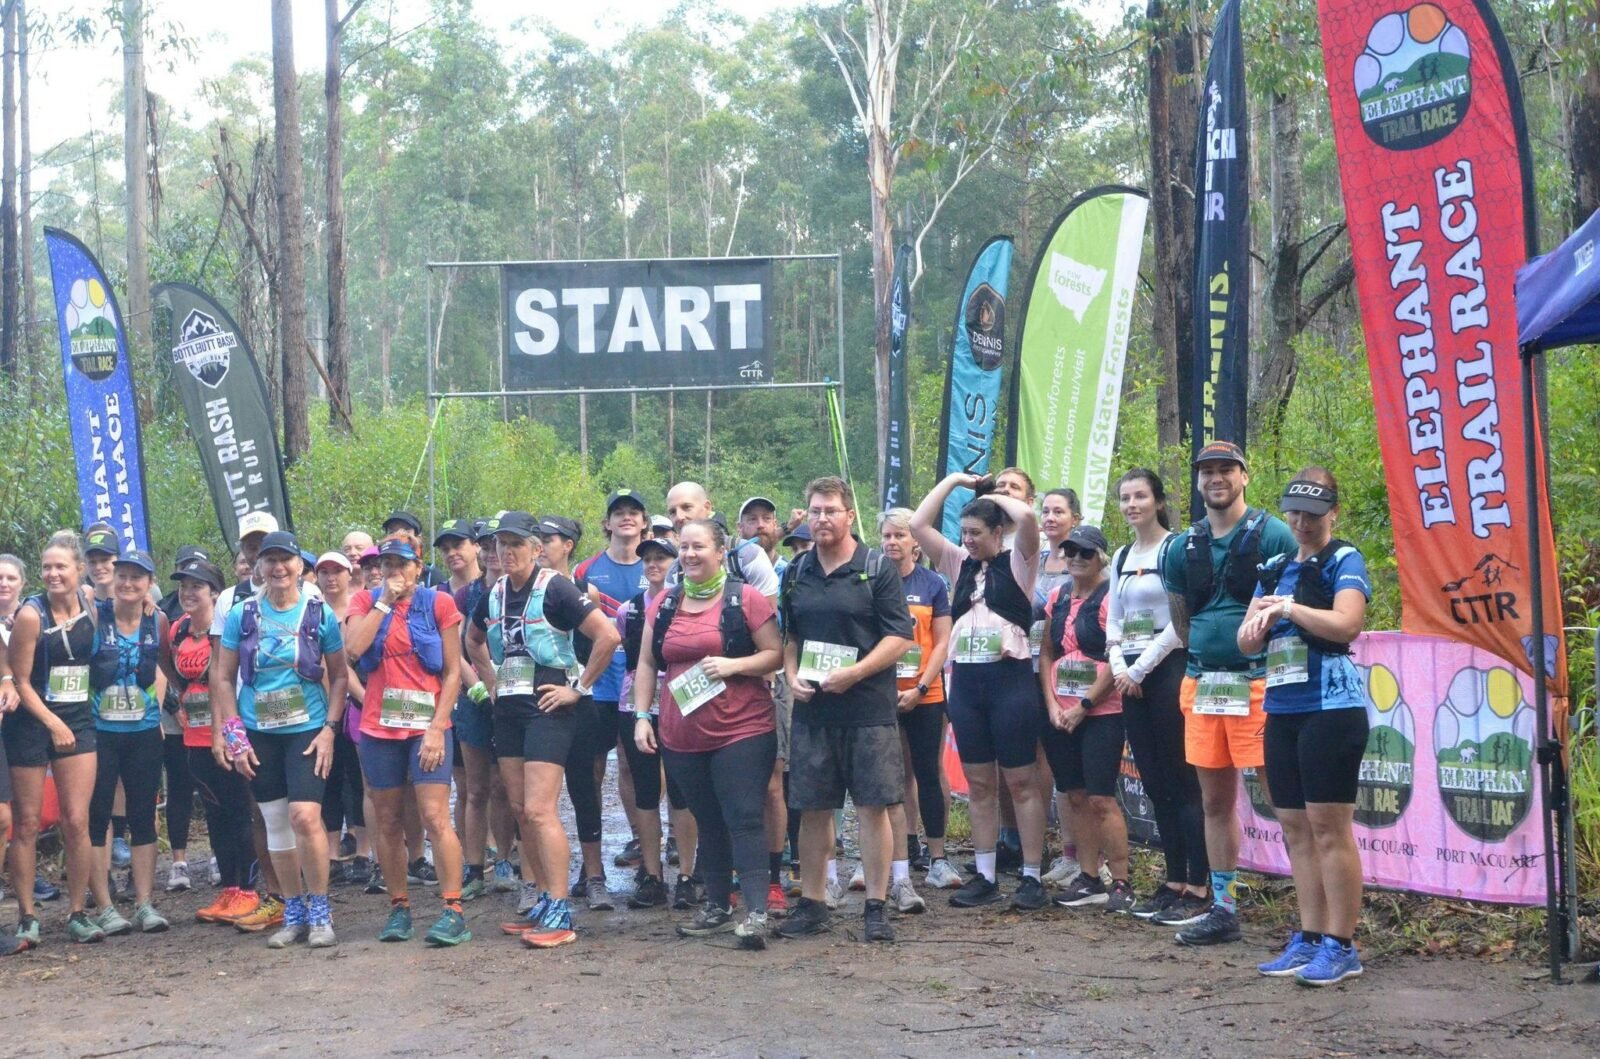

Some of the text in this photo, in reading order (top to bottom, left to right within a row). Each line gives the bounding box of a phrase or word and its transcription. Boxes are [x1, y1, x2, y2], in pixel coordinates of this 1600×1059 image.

[1362, 75, 1467, 122] ELEPHANT
[1380, 103, 1458, 142] TRAIL RACE
[1054, 269, 1092, 297] forests
[513, 284, 762, 356] START
[1105, 287, 1129, 376] Forests
[173, 335, 236, 361] BOTTLEBUTT BASH
[972, 331, 1002, 351] DENNIS
[1434, 159, 1513, 539] TRAIL RACE
[740, 369, 763, 378] CTTR
[1381, 202, 1457, 528] ELEPHANT
[1093, 382, 1114, 446] State
[105, 392, 129, 495] RACE
[205, 397, 239, 465] BASH
[240, 439, 263, 485] RUN
[1087, 452, 1109, 509] NSW
[1450, 591, 1520, 624] CTTR
[967, 637, 988, 651] 152
[815, 654, 842, 671] 159
[63, 676, 81, 691] 151
[685, 675, 710, 698] 158
[1213, 697, 1228, 705] 339
[1454, 795, 1490, 825] TRAIL
[1436, 847, 1467, 864] PORT
